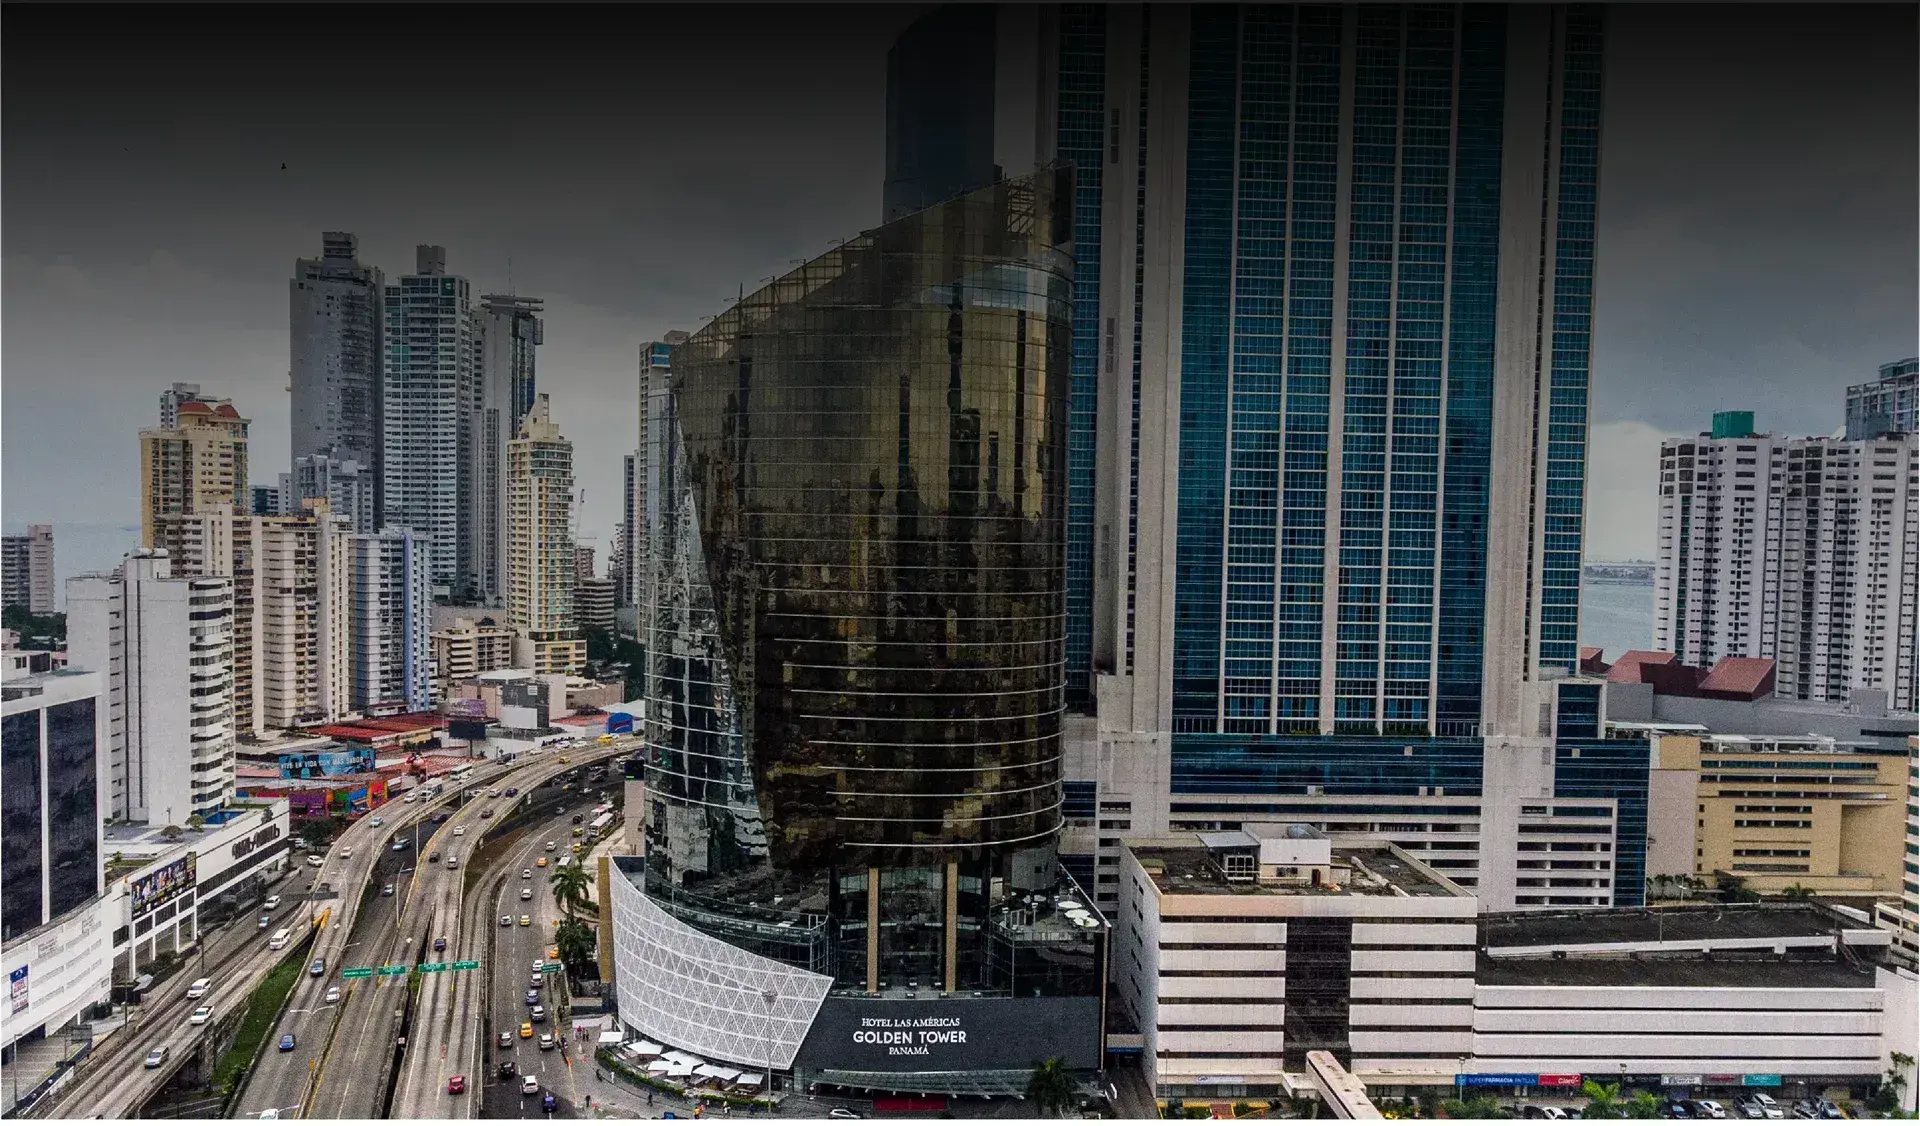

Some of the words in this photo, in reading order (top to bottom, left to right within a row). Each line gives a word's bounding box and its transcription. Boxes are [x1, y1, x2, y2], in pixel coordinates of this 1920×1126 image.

[305, 760, 317, 768] VIDA
[862, 1018, 893, 1027] HOTEL
[894, 1018, 911, 1027] LAS
[913, 1016, 960, 1027] AMÉRICAS
[853, 1030, 912, 1044] GOLDEN
[919, 1030, 966, 1043] TOWER
[889, 1044, 929, 1055] PANAMÁ
